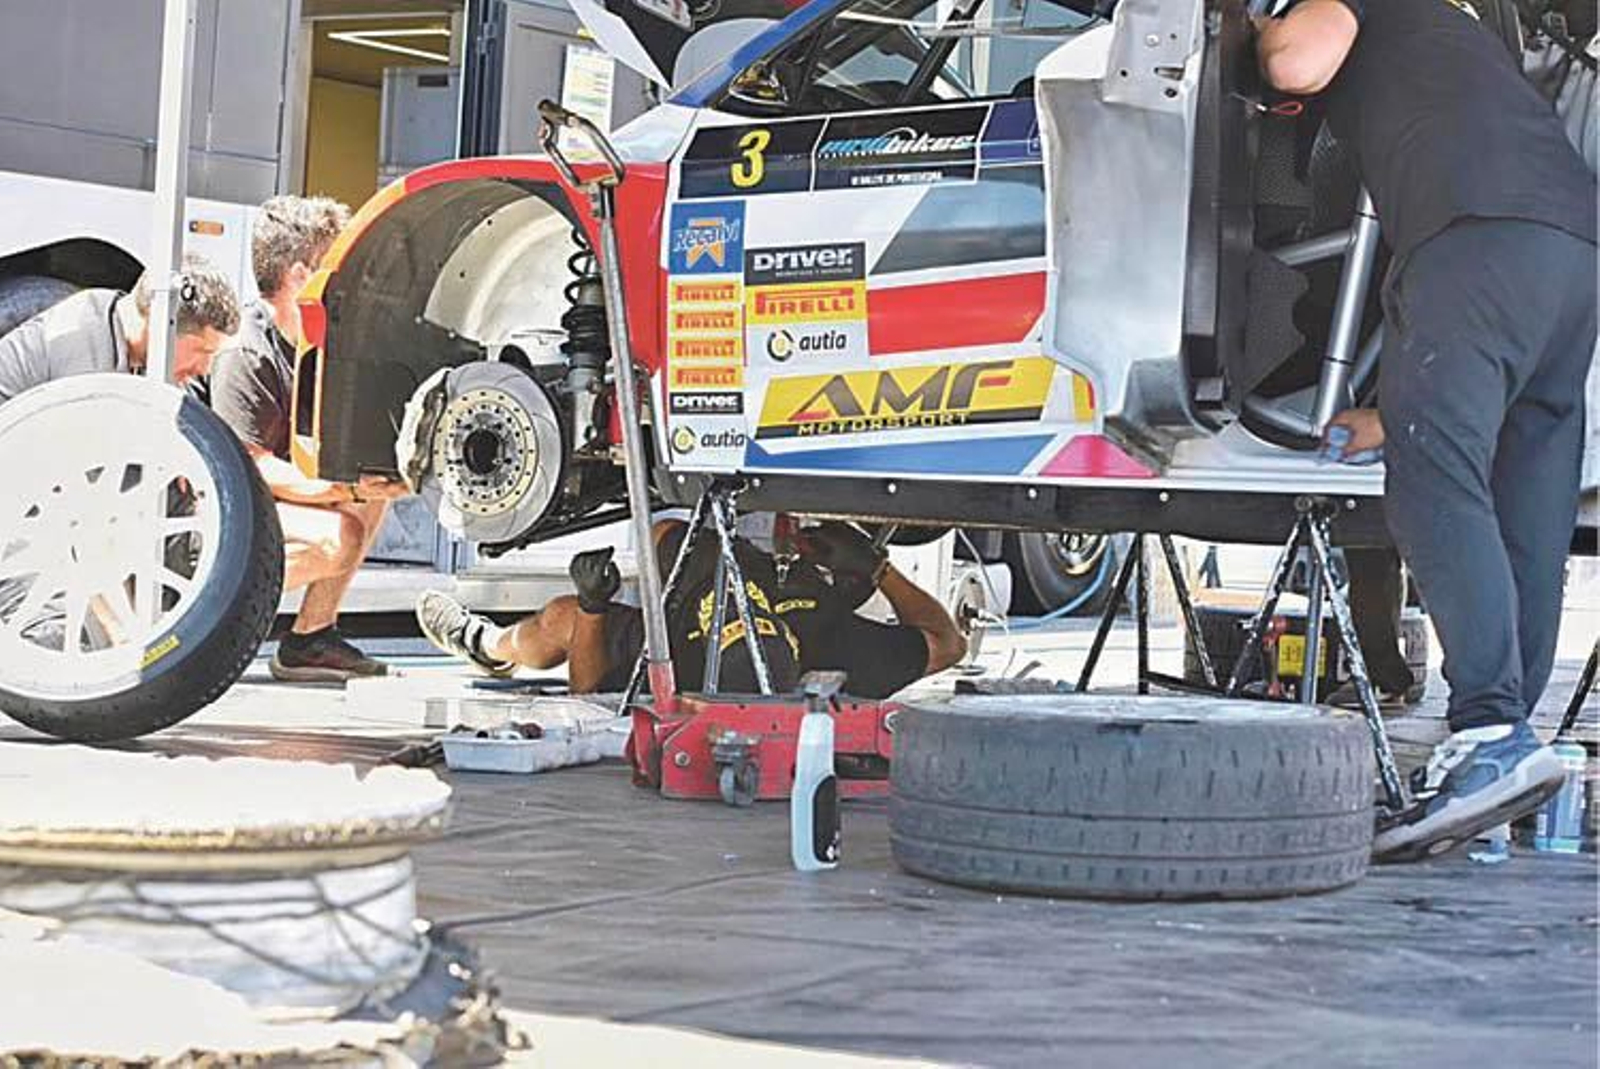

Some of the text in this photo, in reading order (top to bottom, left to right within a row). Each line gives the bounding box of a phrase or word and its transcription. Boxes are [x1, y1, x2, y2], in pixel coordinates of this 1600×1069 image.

[731, 131, 771, 187] 3
[755, 287, 855, 315] PIRELLI
[799, 329, 847, 352] autia
[788, 360, 1014, 422] AMF
[798, 412, 971, 436] MOTORSPORT
[701, 428, 745, 448] autia
